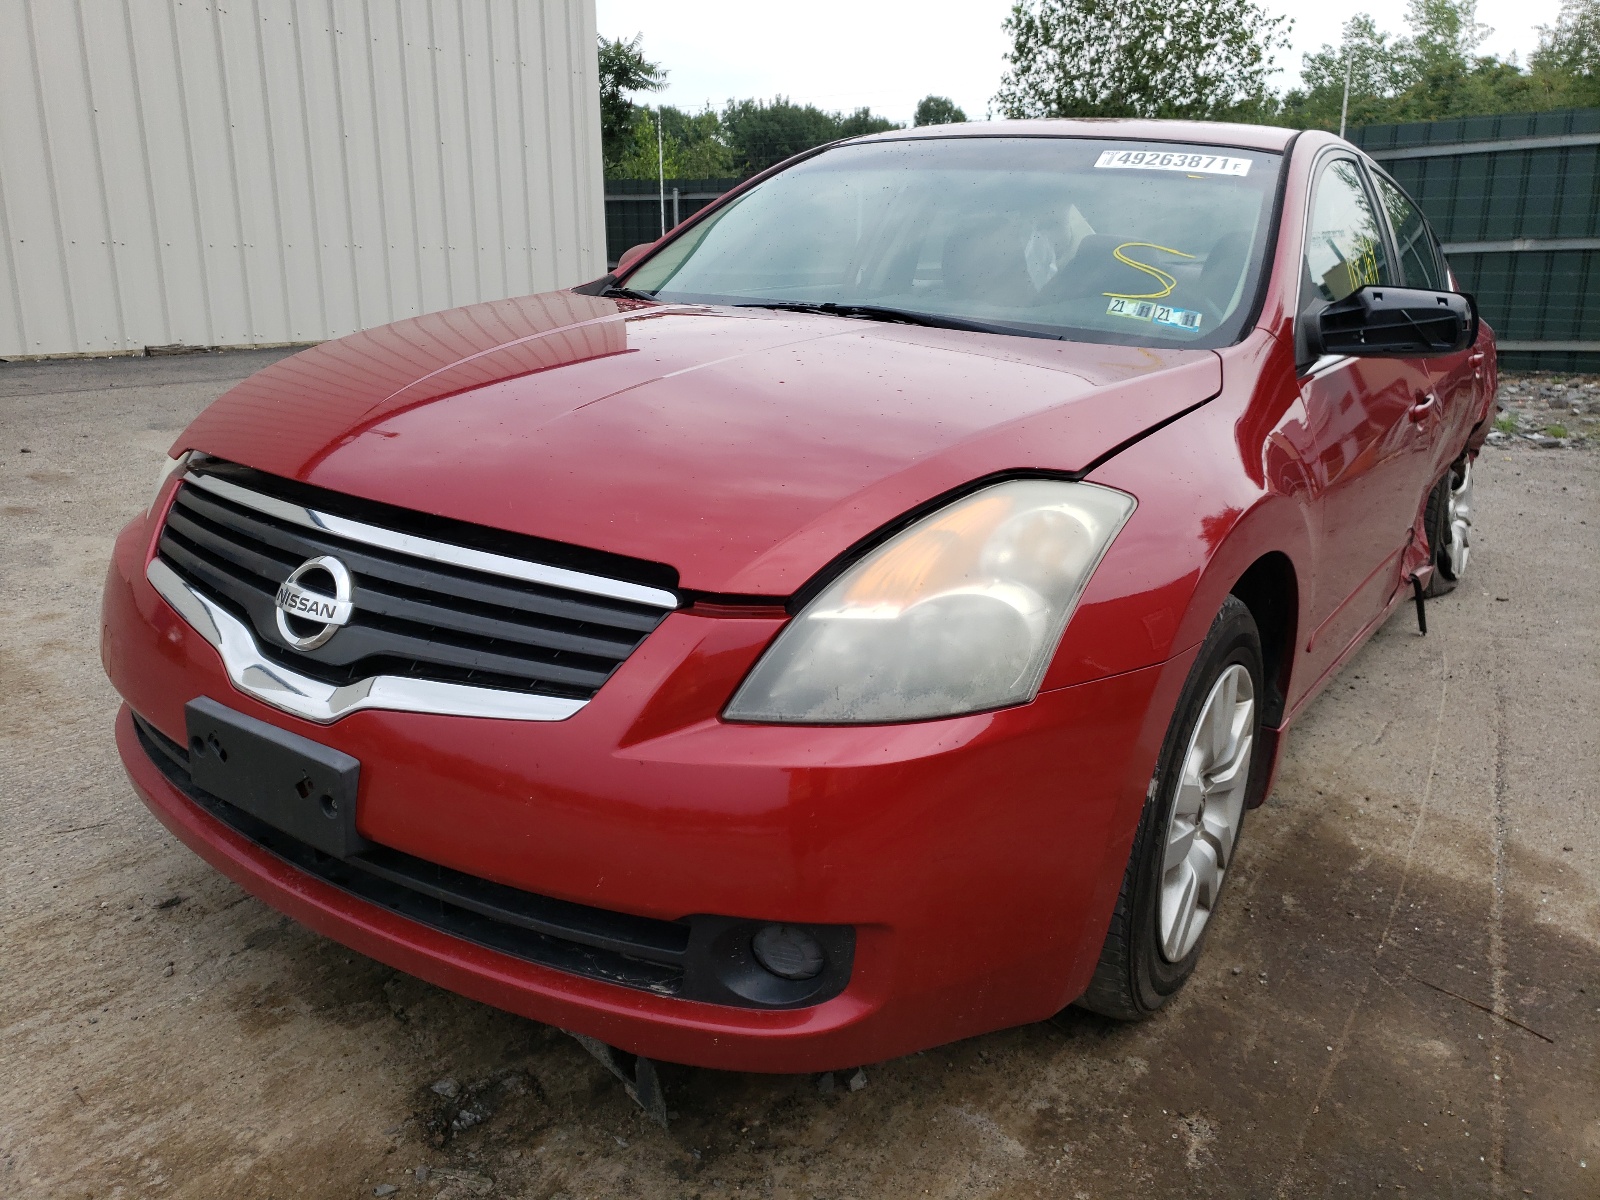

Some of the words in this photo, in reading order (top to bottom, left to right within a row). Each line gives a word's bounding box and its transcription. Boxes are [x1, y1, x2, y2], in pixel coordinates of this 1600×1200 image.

[1116, 152, 1230, 170] 49263871
[1111, 299, 1126, 313] 21
[1157, 307, 1171, 322] 21
[277, 588, 337, 618] NISSAN
